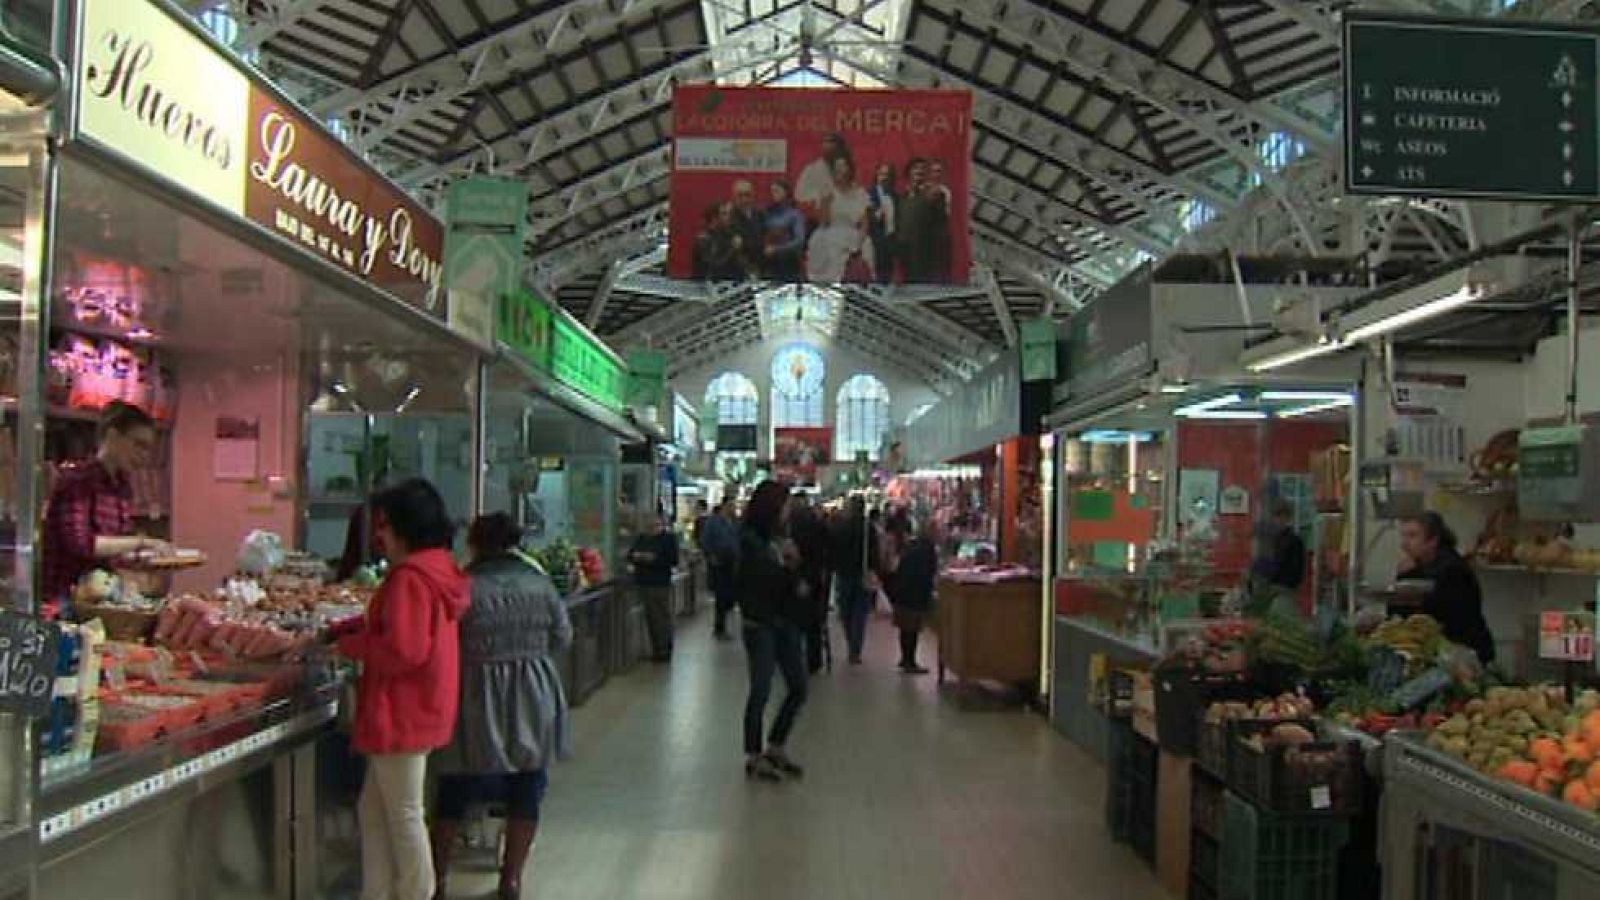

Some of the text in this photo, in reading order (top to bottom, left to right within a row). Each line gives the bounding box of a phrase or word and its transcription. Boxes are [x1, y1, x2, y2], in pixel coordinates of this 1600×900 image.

[87, 30, 232, 170] Huevos
[1396, 138, 1448, 156] ASEOS
[251, 112, 364, 236] Laura
[360, 216, 388, 275] y
